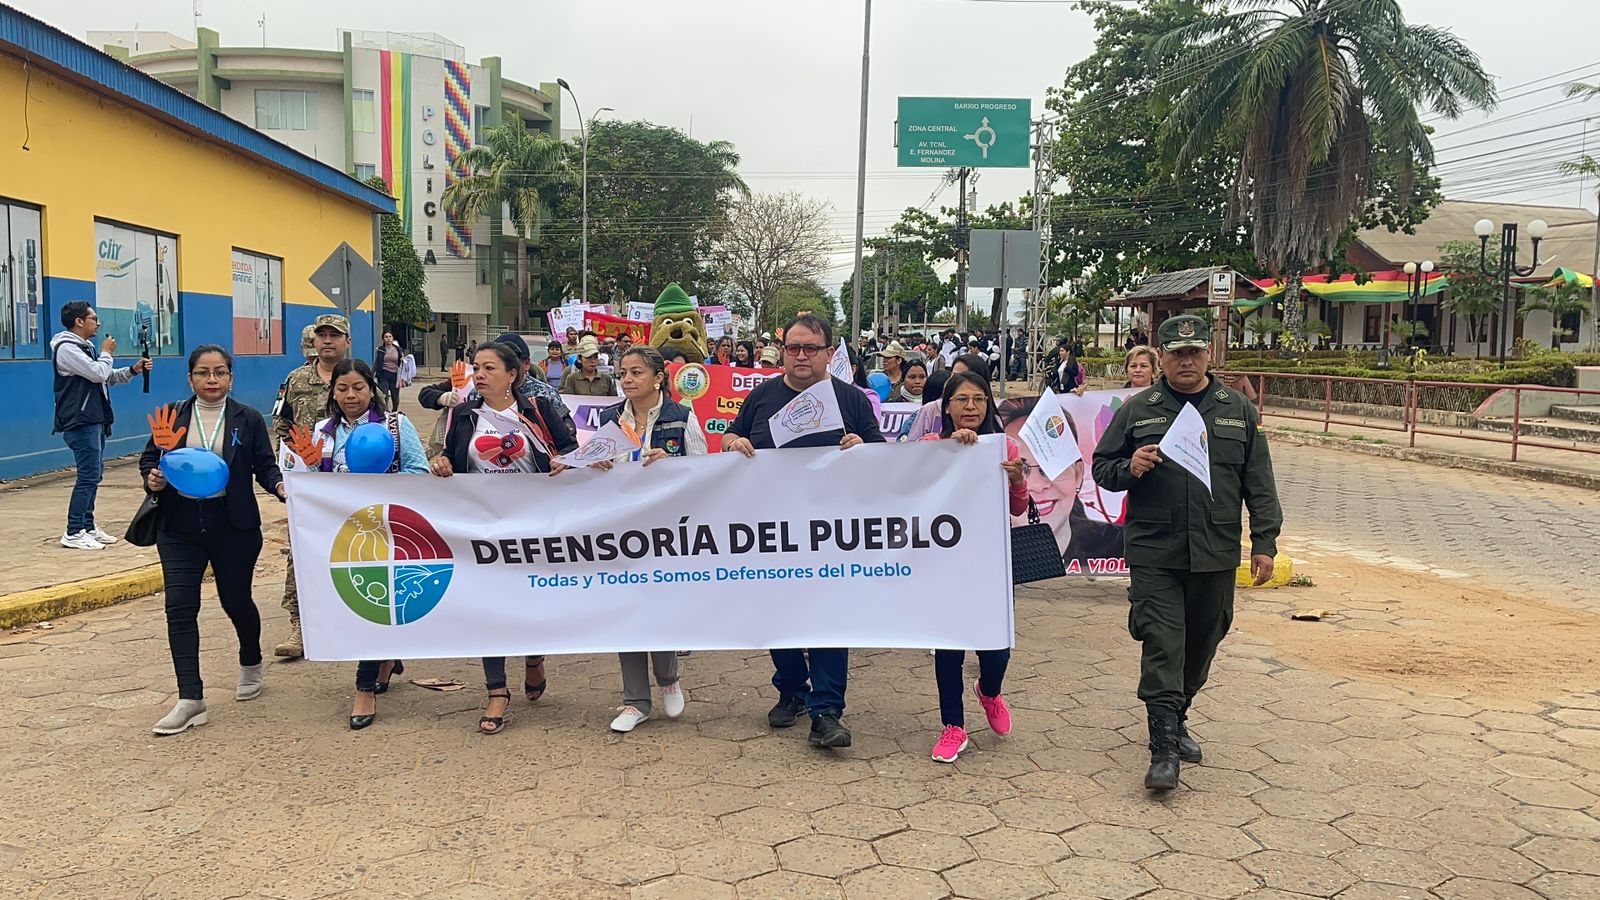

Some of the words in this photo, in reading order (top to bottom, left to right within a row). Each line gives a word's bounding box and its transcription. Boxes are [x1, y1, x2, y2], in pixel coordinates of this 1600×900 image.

[422, 105, 437, 265] POLICIA
[635, 310, 641, 320] 9
[717, 397, 743, 410] Los
[707, 420, 726, 432] de
[471, 516, 720, 565] DEFENSORÍA
[729, 521, 799, 555] DEL
[809, 514, 963, 552] PUEBLO
[528, 573, 578, 588] Todas
[582, 575, 593, 589] y
[597, 570, 649, 585] Todos
[653, 568, 712, 583] Somos
[716, 563, 813, 581] Defensores
[818, 563, 845, 578] del
[850, 562, 912, 577] Pueblo
